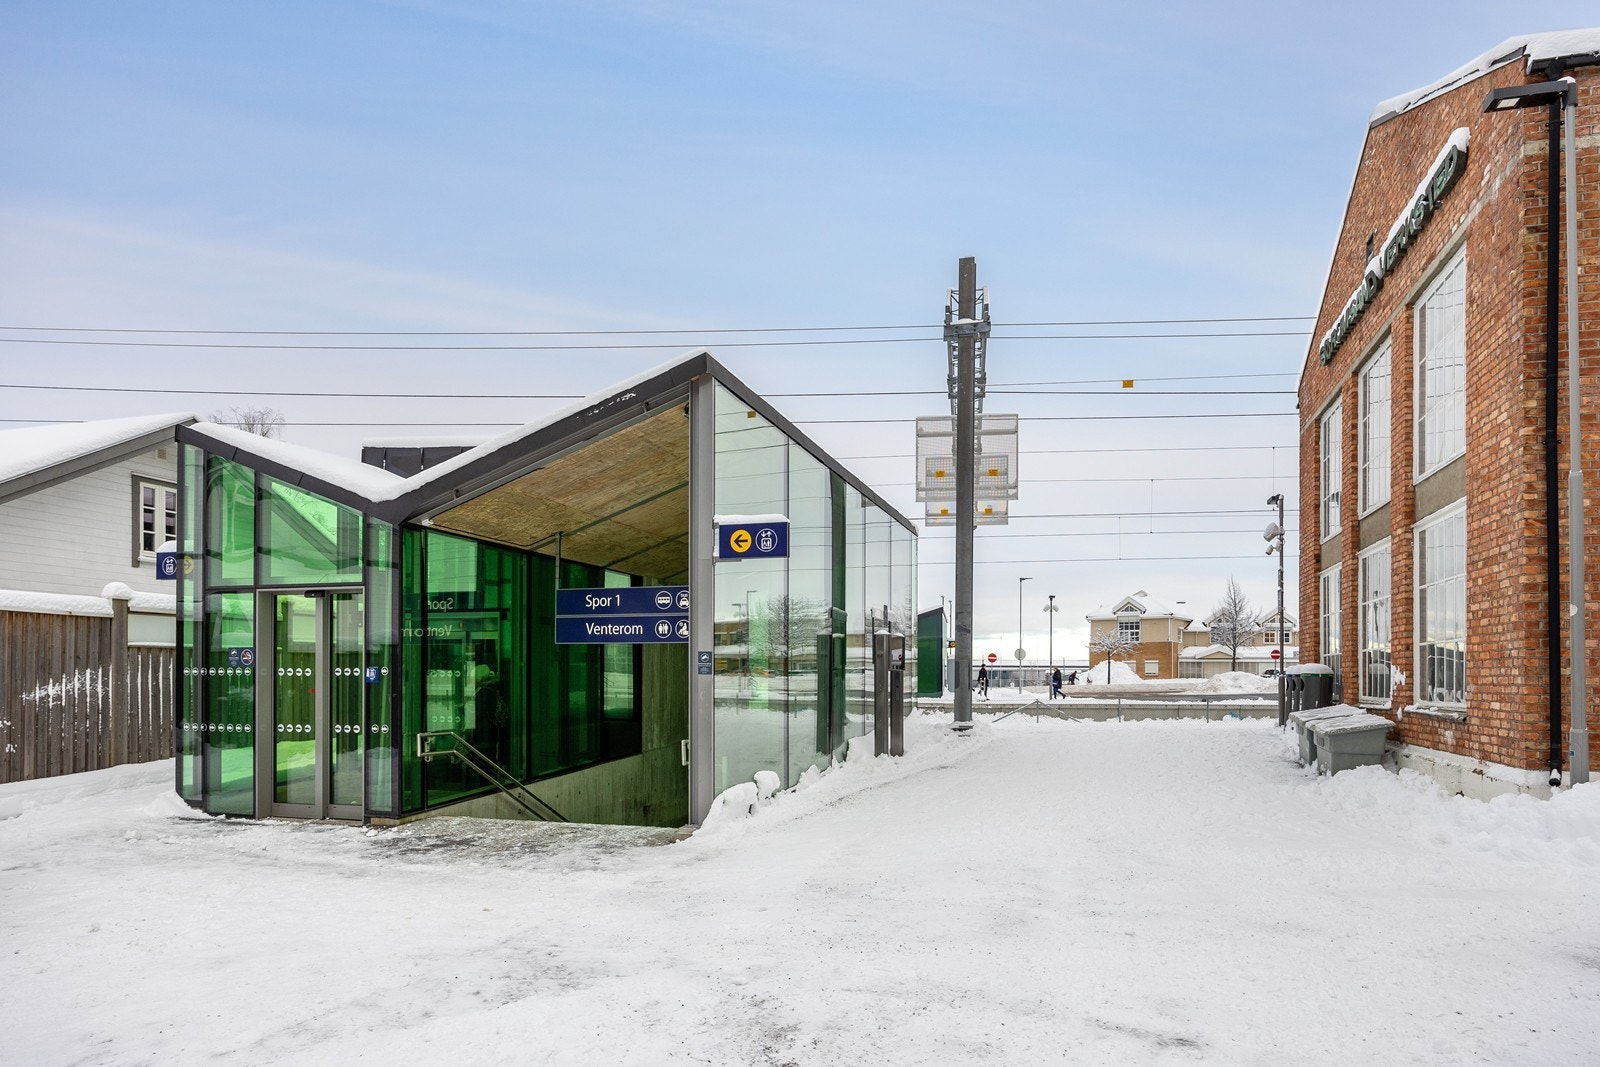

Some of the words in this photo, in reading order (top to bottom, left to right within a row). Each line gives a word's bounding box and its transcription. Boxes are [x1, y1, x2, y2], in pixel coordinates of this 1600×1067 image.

[585, 594, 612, 610] Spor
[615, 594, 621, 607] 1
[585, 622, 644, 635] Venterom
